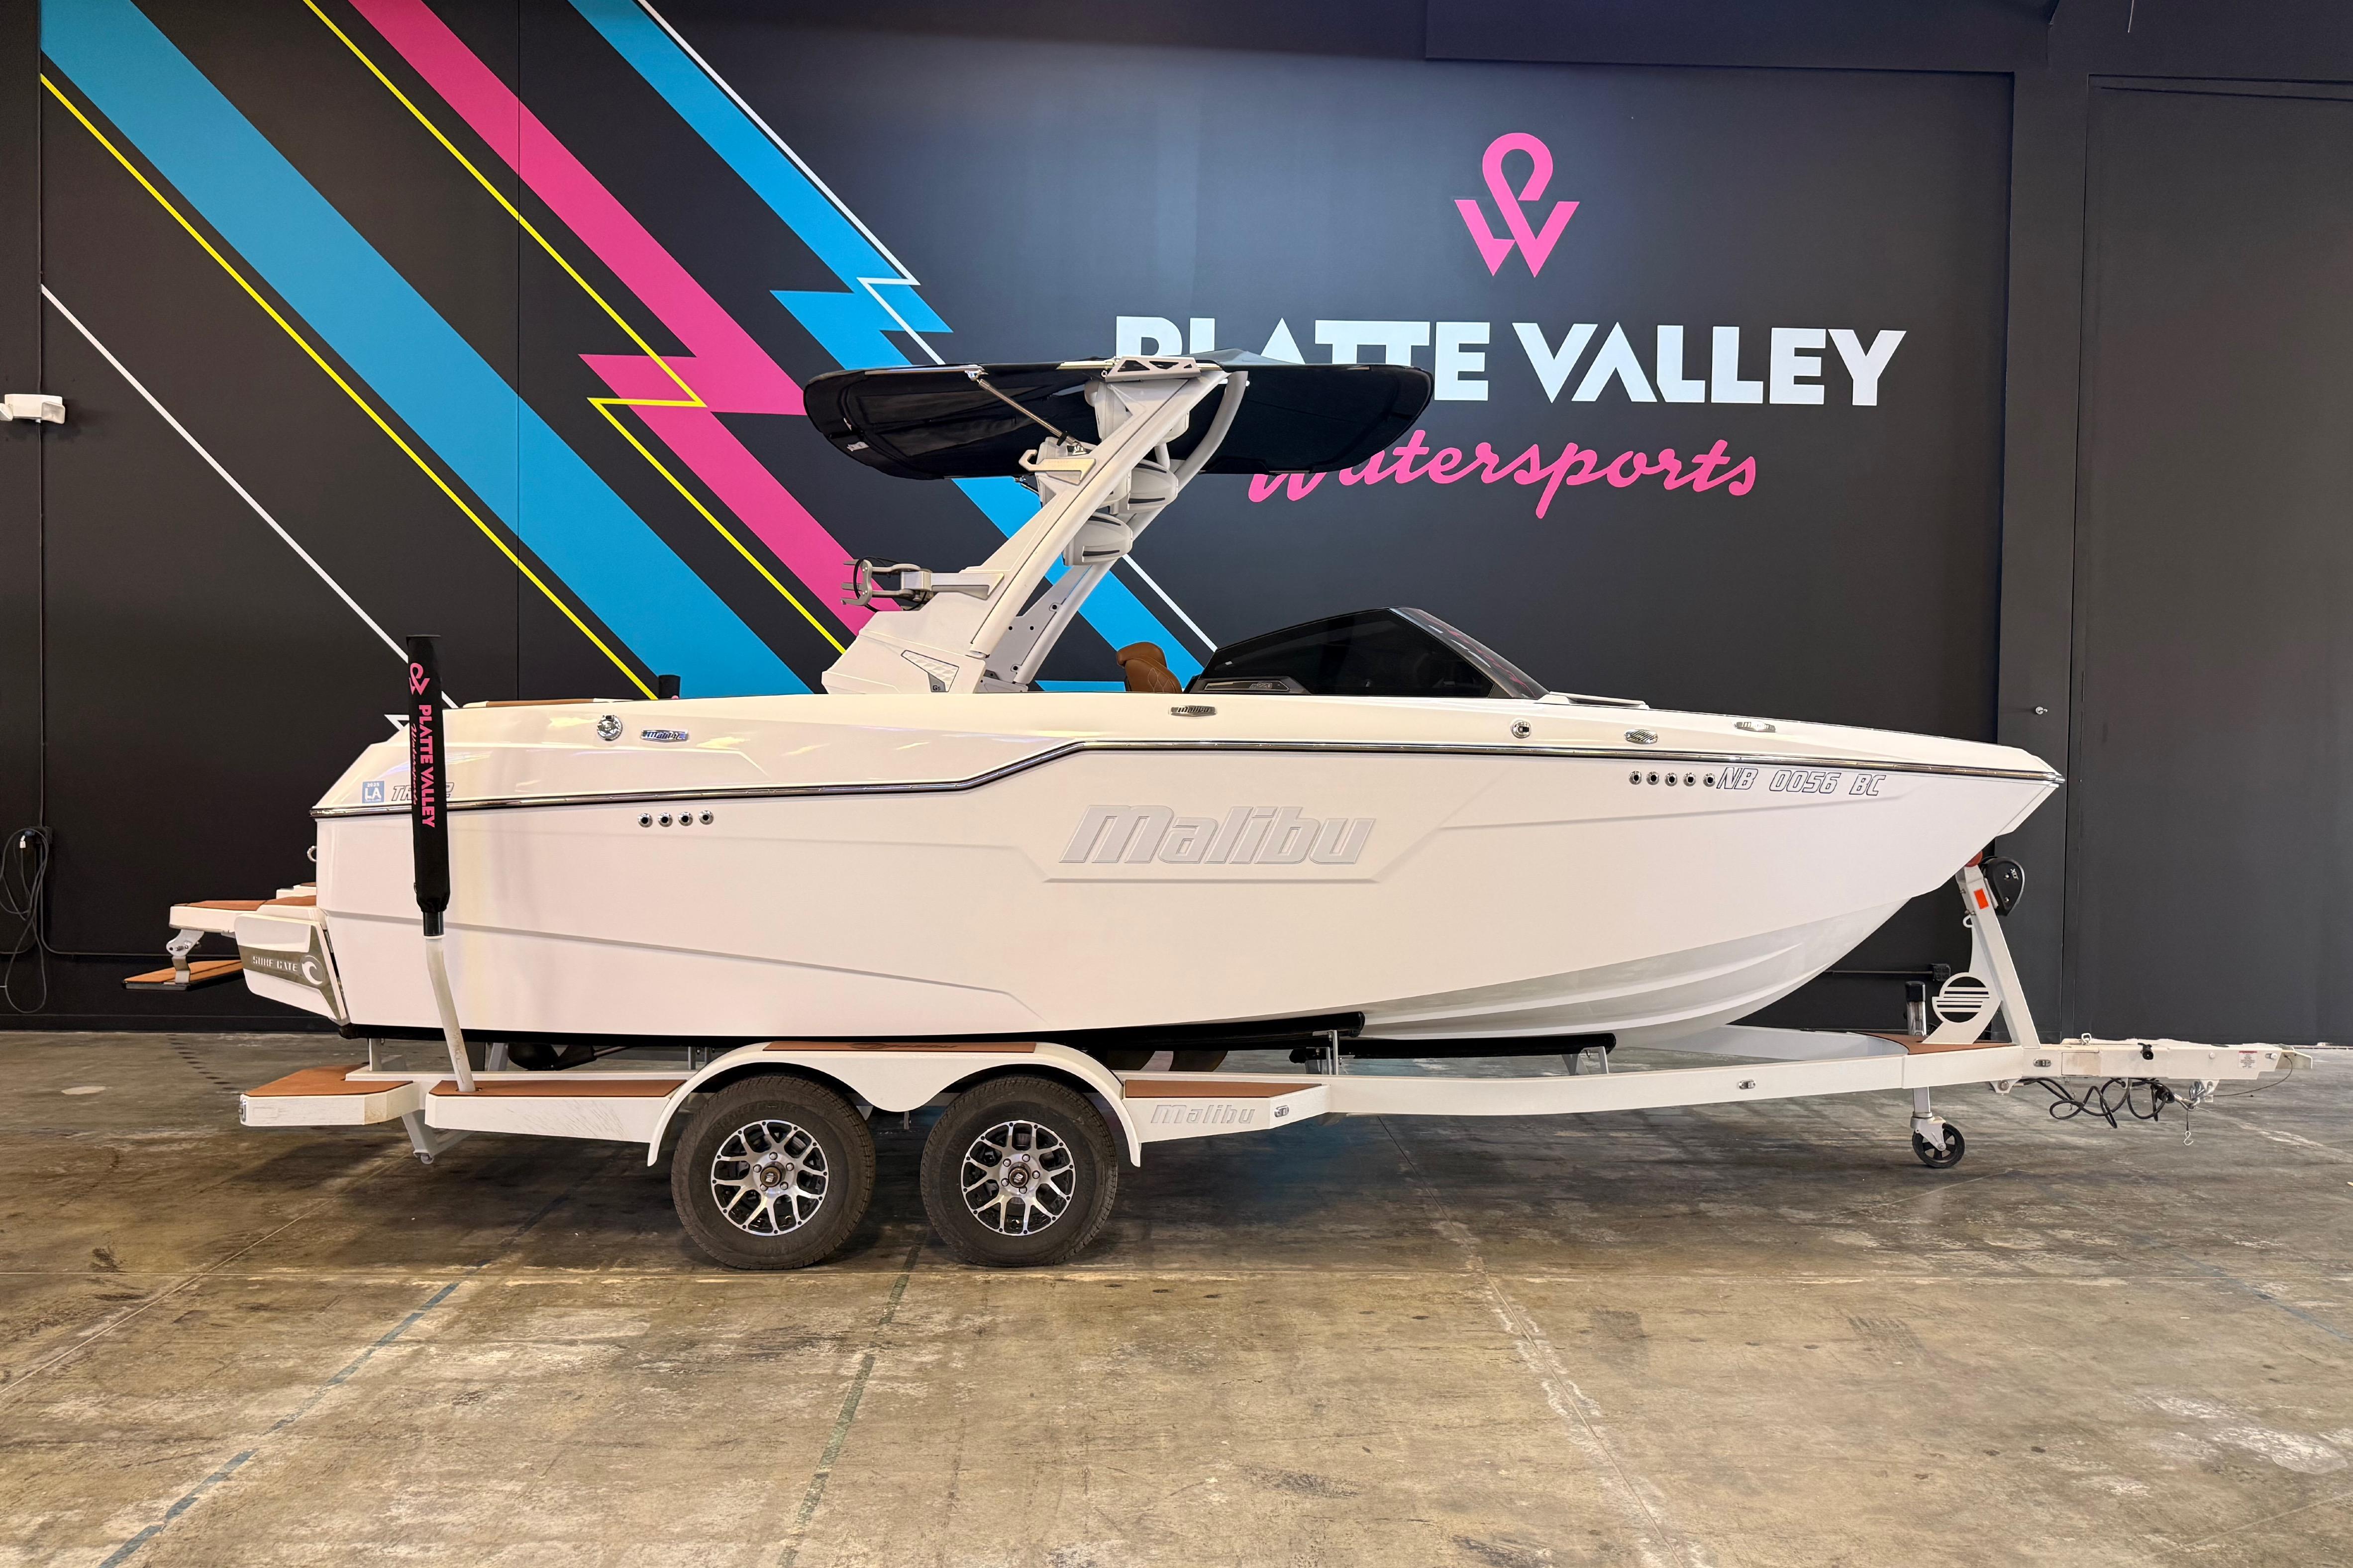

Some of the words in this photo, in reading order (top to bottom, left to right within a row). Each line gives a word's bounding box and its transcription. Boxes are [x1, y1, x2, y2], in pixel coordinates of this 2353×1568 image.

[1512, 321, 1907, 406] VALLEY
[419, 704, 433, 764] PLATTE
[364, 787, 382, 800] LA
[420, 766, 435, 828] VALLEY
[1716, 767, 1759, 790] NB
[1769, 769, 1842, 794] 0056
[1848, 773, 1887, 796] BC
[1058, 804, 1377, 865] Malibu
[1150, 1104, 1256, 1124] Malibu
